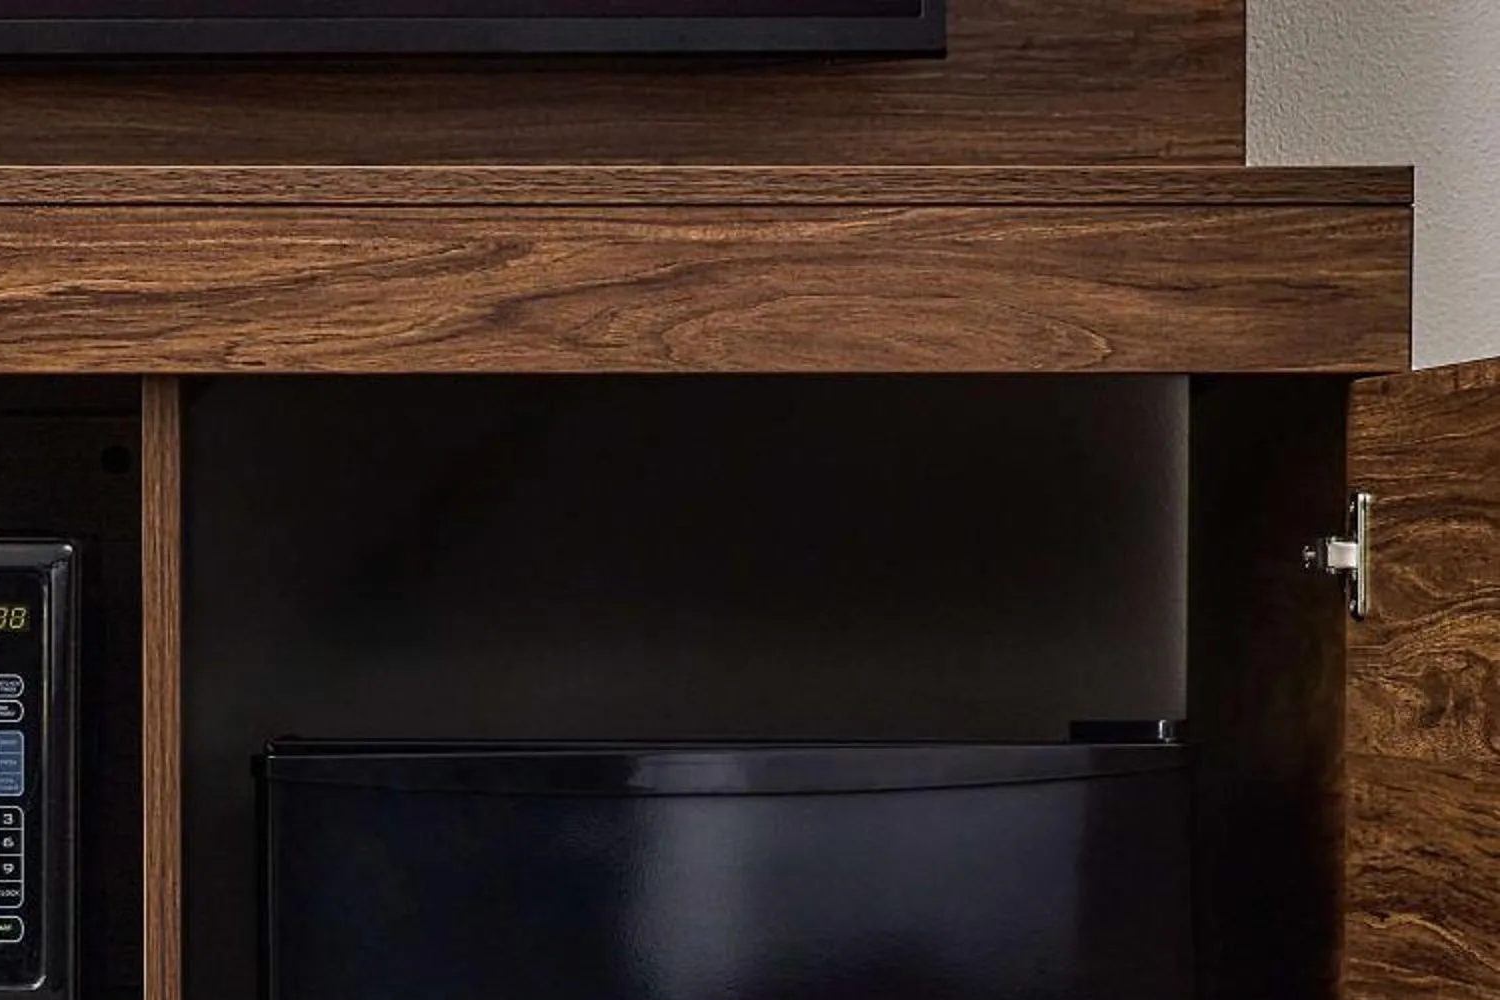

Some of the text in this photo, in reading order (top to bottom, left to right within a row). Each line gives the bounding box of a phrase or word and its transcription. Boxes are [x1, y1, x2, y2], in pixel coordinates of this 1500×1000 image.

[3, 813, 13, 825] 3
[3, 837, 14, 848] 6
[3, 863, 14, 874] 9
